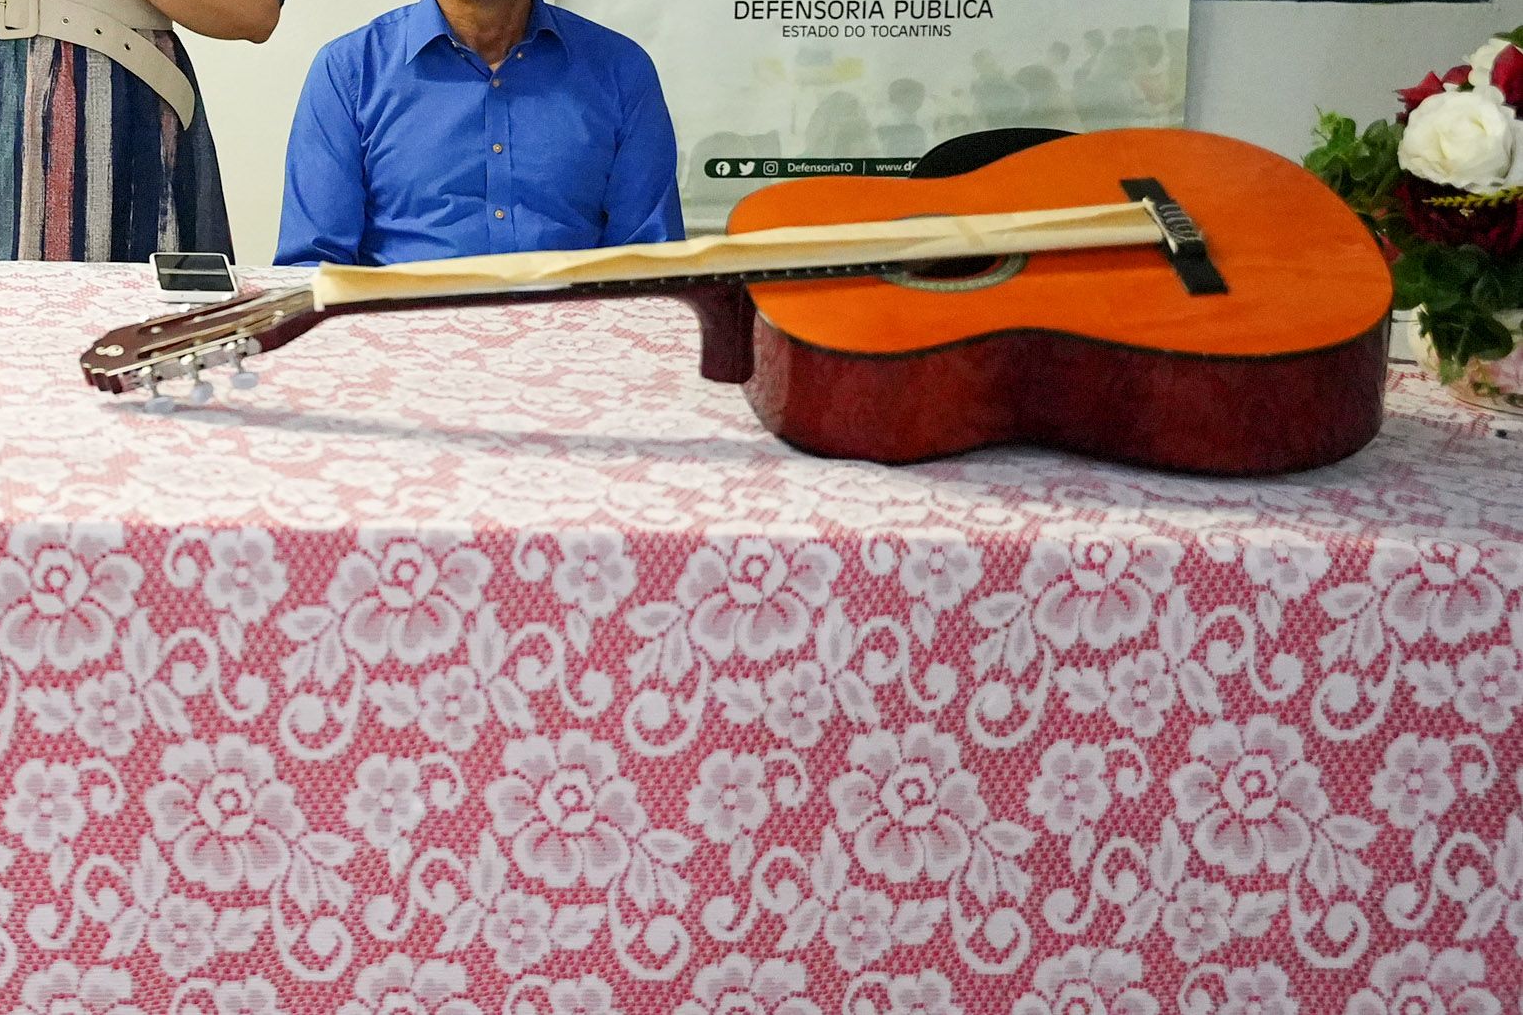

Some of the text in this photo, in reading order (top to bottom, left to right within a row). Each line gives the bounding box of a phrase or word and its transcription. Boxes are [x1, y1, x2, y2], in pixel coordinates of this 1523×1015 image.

[735, 0, 884, 19] DEFENSORIA
[783, 25, 951, 37] ESTADO DO TOCANTINS
[787, 162, 853, 173] DefensoriaTO
